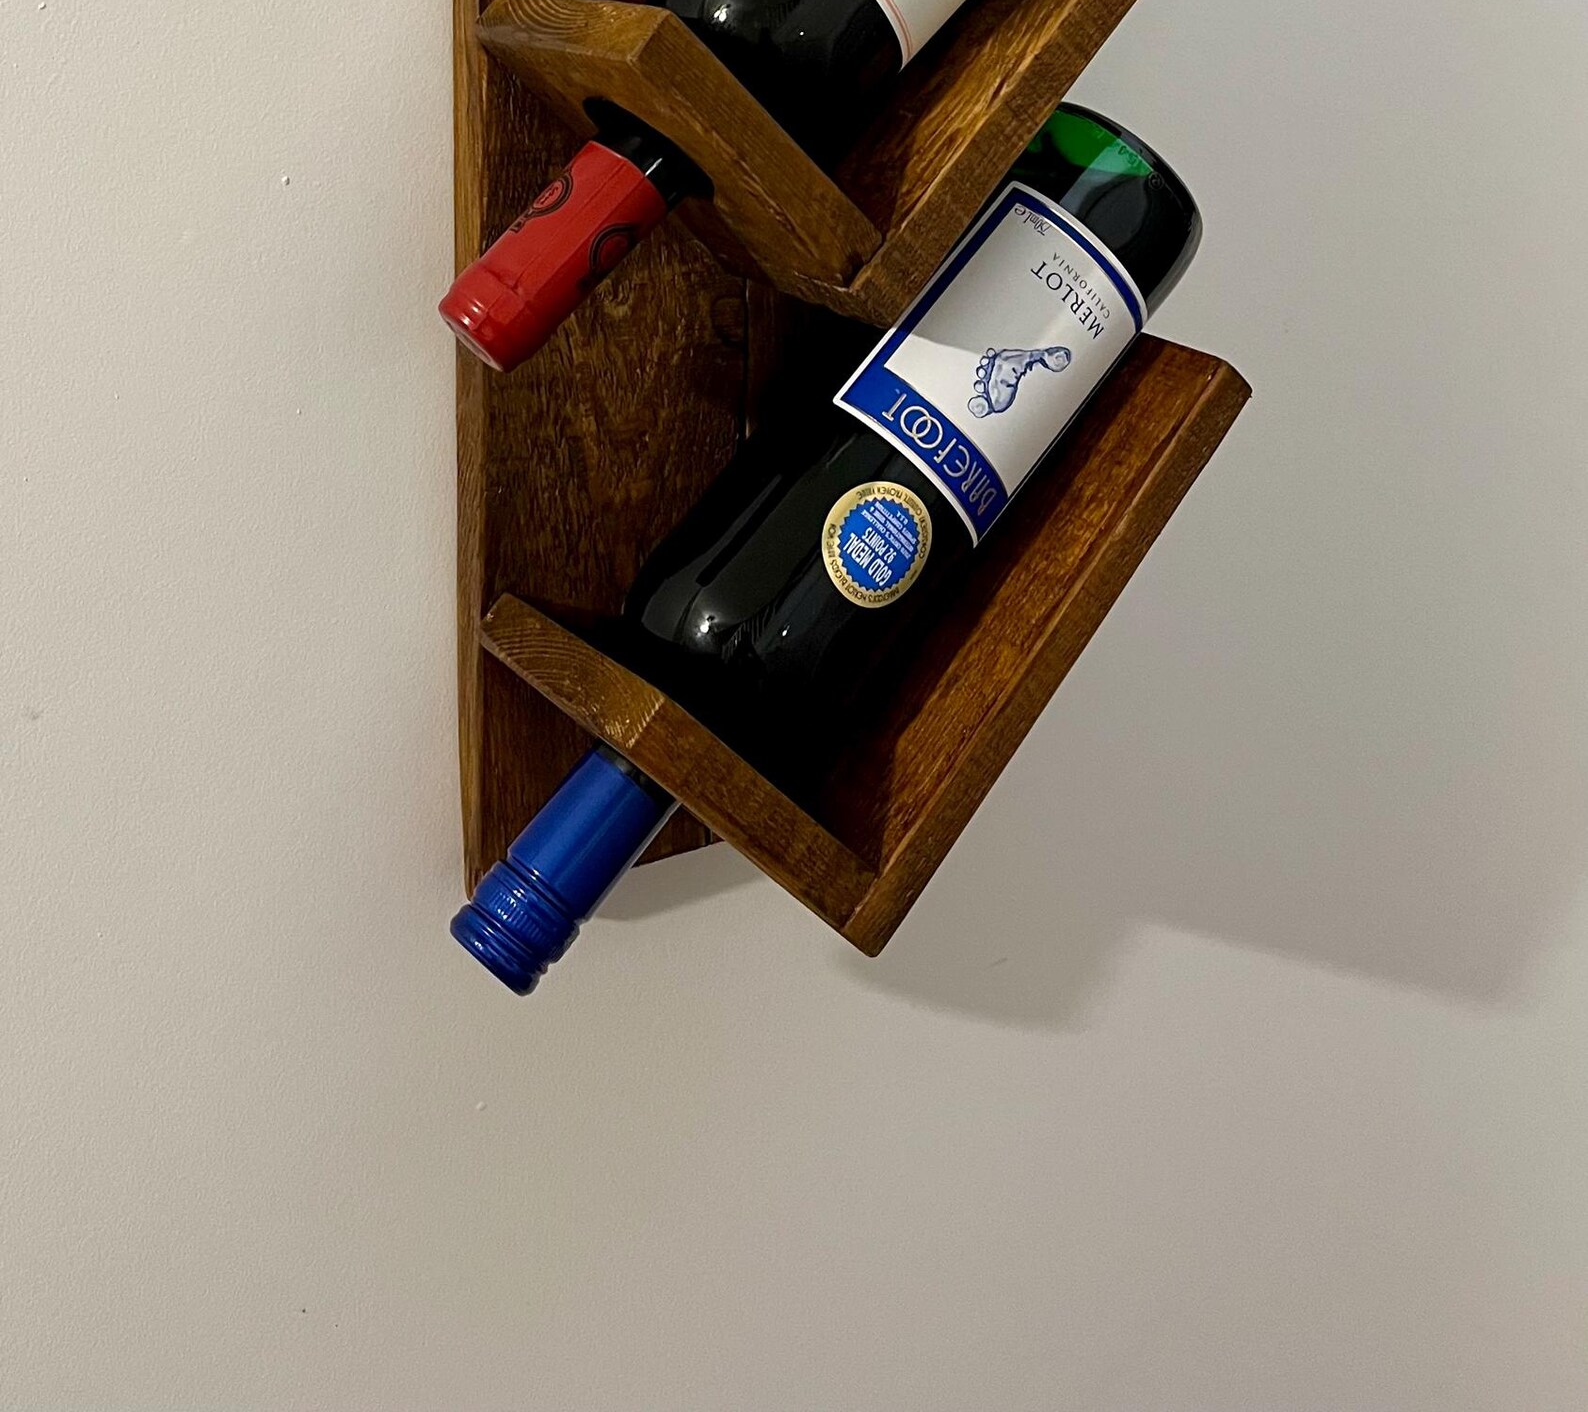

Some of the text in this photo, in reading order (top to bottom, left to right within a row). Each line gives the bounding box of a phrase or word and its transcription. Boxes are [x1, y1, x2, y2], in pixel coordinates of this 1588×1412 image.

[1030, 260, 1105, 340] MERLOT
[1052, 252, 1111, 319] CALIFORNIA
[882, 393, 998, 516] BAREFOOT
[842, 532, 893, 587] GOLD MEDAL
[861, 527, 897, 564] 92 POINTS
